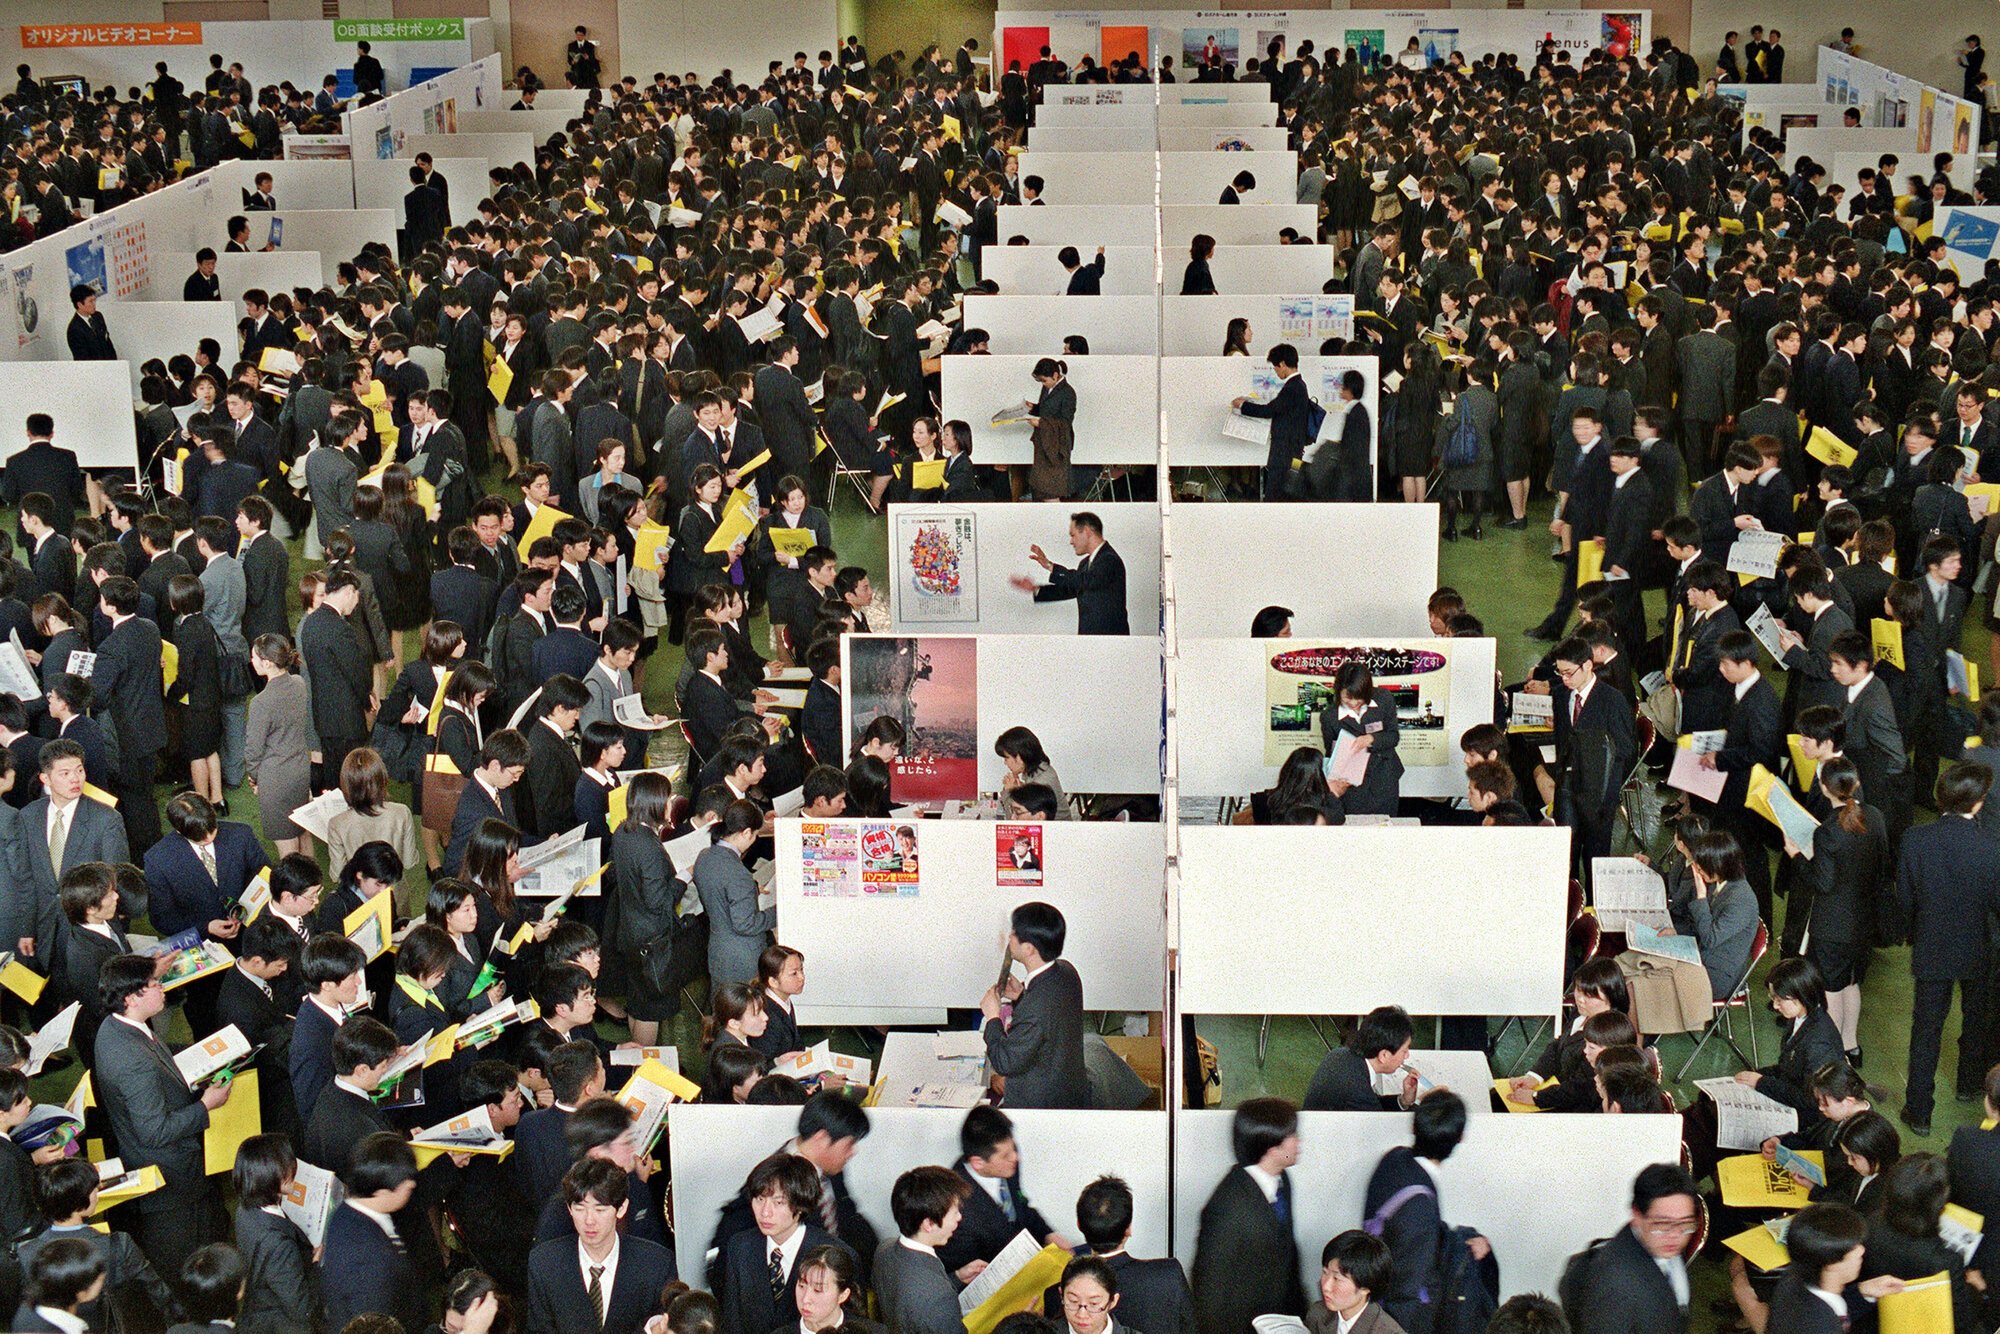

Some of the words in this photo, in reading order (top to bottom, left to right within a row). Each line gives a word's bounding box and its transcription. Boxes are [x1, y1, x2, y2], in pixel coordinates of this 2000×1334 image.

[26, 26, 194, 44] オリジナルビデオコーナー
[337, 22, 462, 37] OB面談受付ボックス
